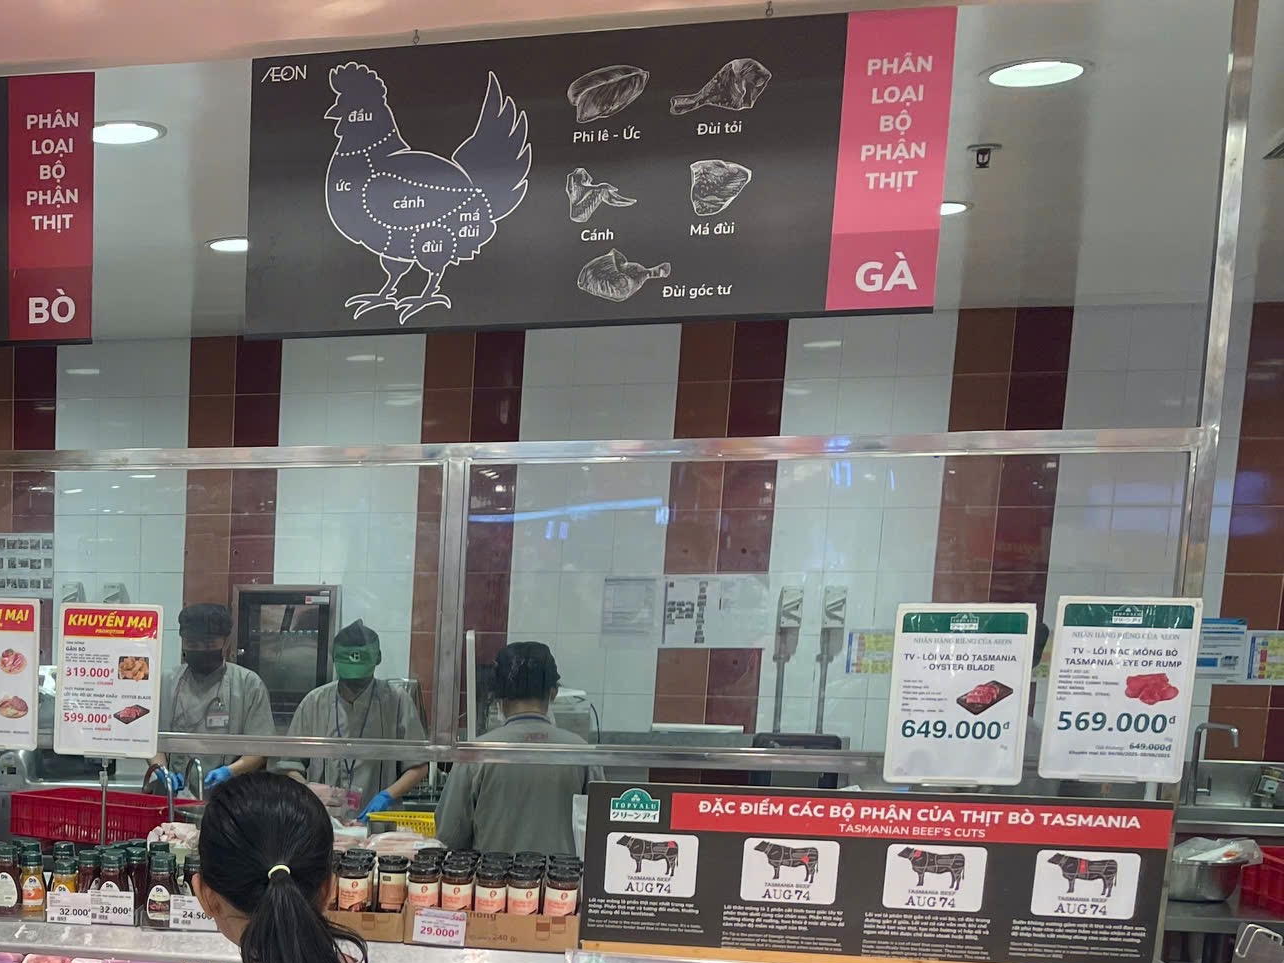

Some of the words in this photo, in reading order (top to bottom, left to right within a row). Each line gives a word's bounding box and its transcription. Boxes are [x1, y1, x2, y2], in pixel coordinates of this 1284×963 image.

[867, 52, 933, 76] PHÂN
[871, 84, 924, 106] LOẠI
[26, 109, 79, 130] PHÂN
[879, 109, 912, 135] BỘ
[573, 131, 594, 143] Phi
[598, 129, 609, 142] lê
[623, 125, 641, 140] Ức
[697, 123, 721, 135] Đùi
[724, 121, 742, 133] tỏi
[31, 138, 74, 157] LOẠI
[860, 138, 926, 164] PHẬN
[39, 160, 66, 183] BỘ
[335, 179, 352, 191] ức
[865, 170, 918, 192] THỊT
[26, 186, 78, 208] PHẬN
[393, 196, 425, 209] cánh
[31, 213, 73, 233] THỊT
[459, 209, 480, 222] má
[458, 225, 480, 238] đùi
[580, 229, 614, 242] Cánh
[690, 222, 710, 236] Má
[714, 222, 735, 235] đùi
[422, 240, 443, 253] đùi
[855, 251, 918, 292] GÀ
[662, 285, 686, 298] Đùi
[689, 284, 713, 299] góc
[717, 284, 732, 295] tư
[28, 288, 76, 325] BÒ
[5, 608, 29, 624] MẠI
[68, 611, 124, 628] KHUYẾN
[126, 617, 153, 631] MẠI
[904, 653, 915, 661] TV
[956, 653, 969, 662] BÒ
[972, 654, 1017, 662] TASMANIA
[1065, 658, 1114, 666] TASMANIA
[929, 663, 964, 671] OYSTER
[902, 719, 1010, 740] 649.000đ
[1057, 711, 1176, 734] 569.000đ
[614, 801, 657, 810] TOPVALU
[611, 811, 658, 821] グリーンアイ
[698, 800, 736, 816] ĐẶC
[740, 799, 784, 817] ĐIỂM
[789, 801, 824, 818] CÁC
[829, 802, 855, 822] BỘ
[860, 803, 912, 821] PHẬN
[916, 805, 954, 822] CỦA
[961, 810, 1000, 827] THỊT
[1007, 809, 1034, 825] BÒ
[1040, 812, 1141, 829] TASMANIA
[839, 824, 909, 835] TASMANIAN
[912, 826, 951, 837] BEEF'S
[954, 828, 986, 838] CUTS
[625, 883, 654, 893] AUG
[656, 883, 671, 894] 74
[762, 890, 792, 899] AUG
[794, 890, 811, 900] 74
[905, 896, 937, 907] AUG
[939, 896, 956, 908] 74
[1054, 904, 1088, 915] AUG
[1090, 904, 1107, 916] 74
